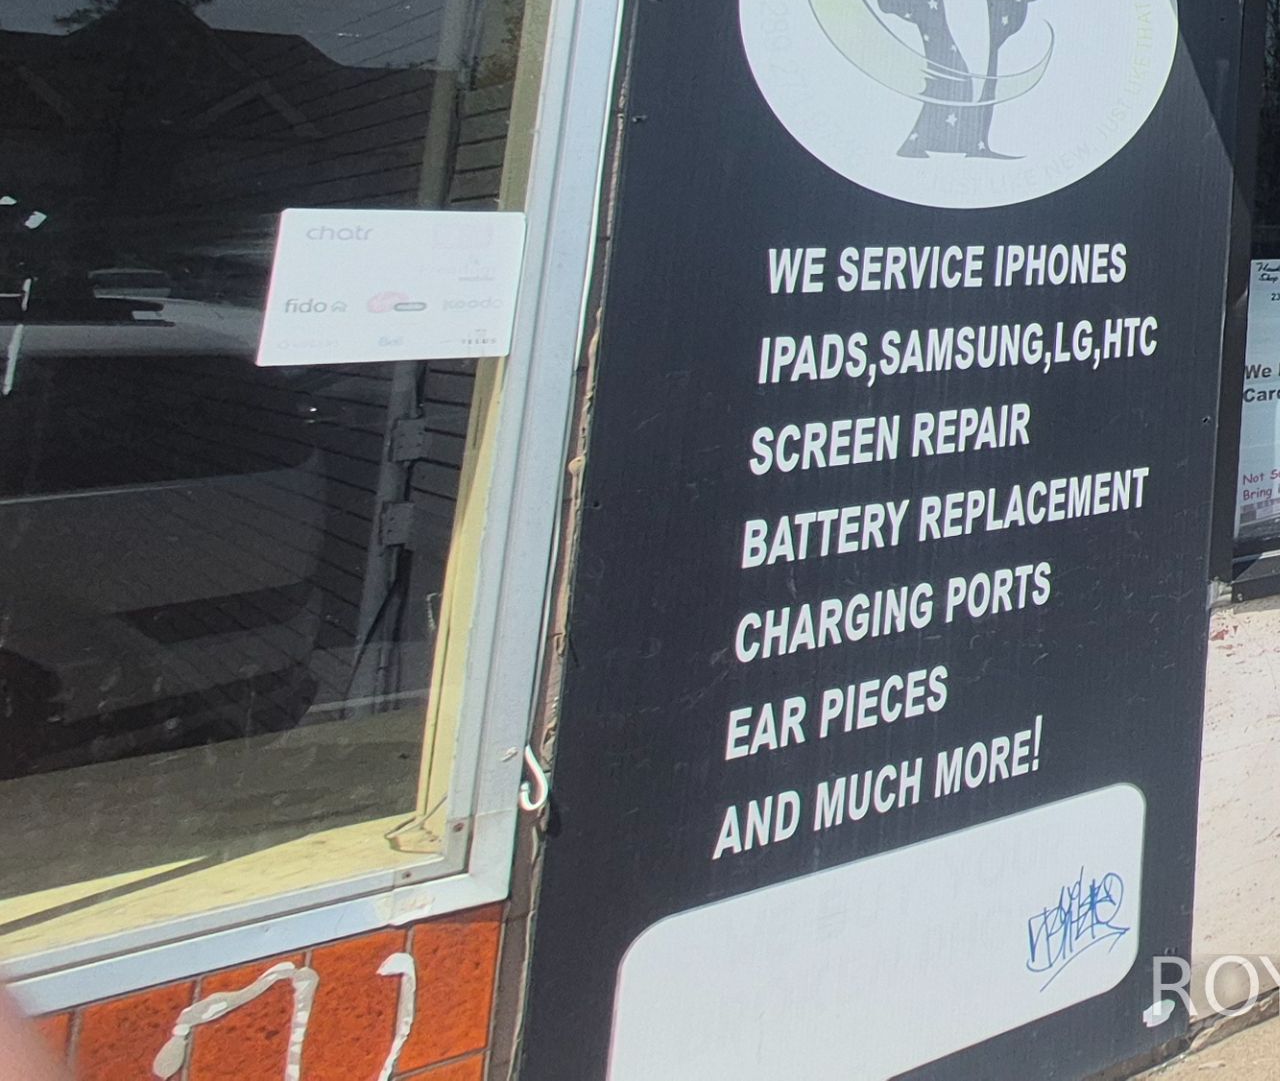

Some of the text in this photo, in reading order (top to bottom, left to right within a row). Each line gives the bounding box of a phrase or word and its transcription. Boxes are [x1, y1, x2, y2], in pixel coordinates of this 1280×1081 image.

[305, 223, 374, 241] chatr
[768, 243, 1128, 295] WE SERVICE IPHONES
[284, 297, 328, 314] fido
[1244, 364, 1272, 379] We
[749, 403, 1031, 476] SCREEN REPAIR
[1242, 473, 1264, 485] Not
[1243, 486, 1272, 501] Bring
[741, 467, 1150, 570] BATTERY REPLACEMENT
[734, 562, 1052, 664] CHARGING PORTS
[725, 665, 949, 761] EAR PIECES
[711, 714, 1044, 860] AND MUCH MORE!
